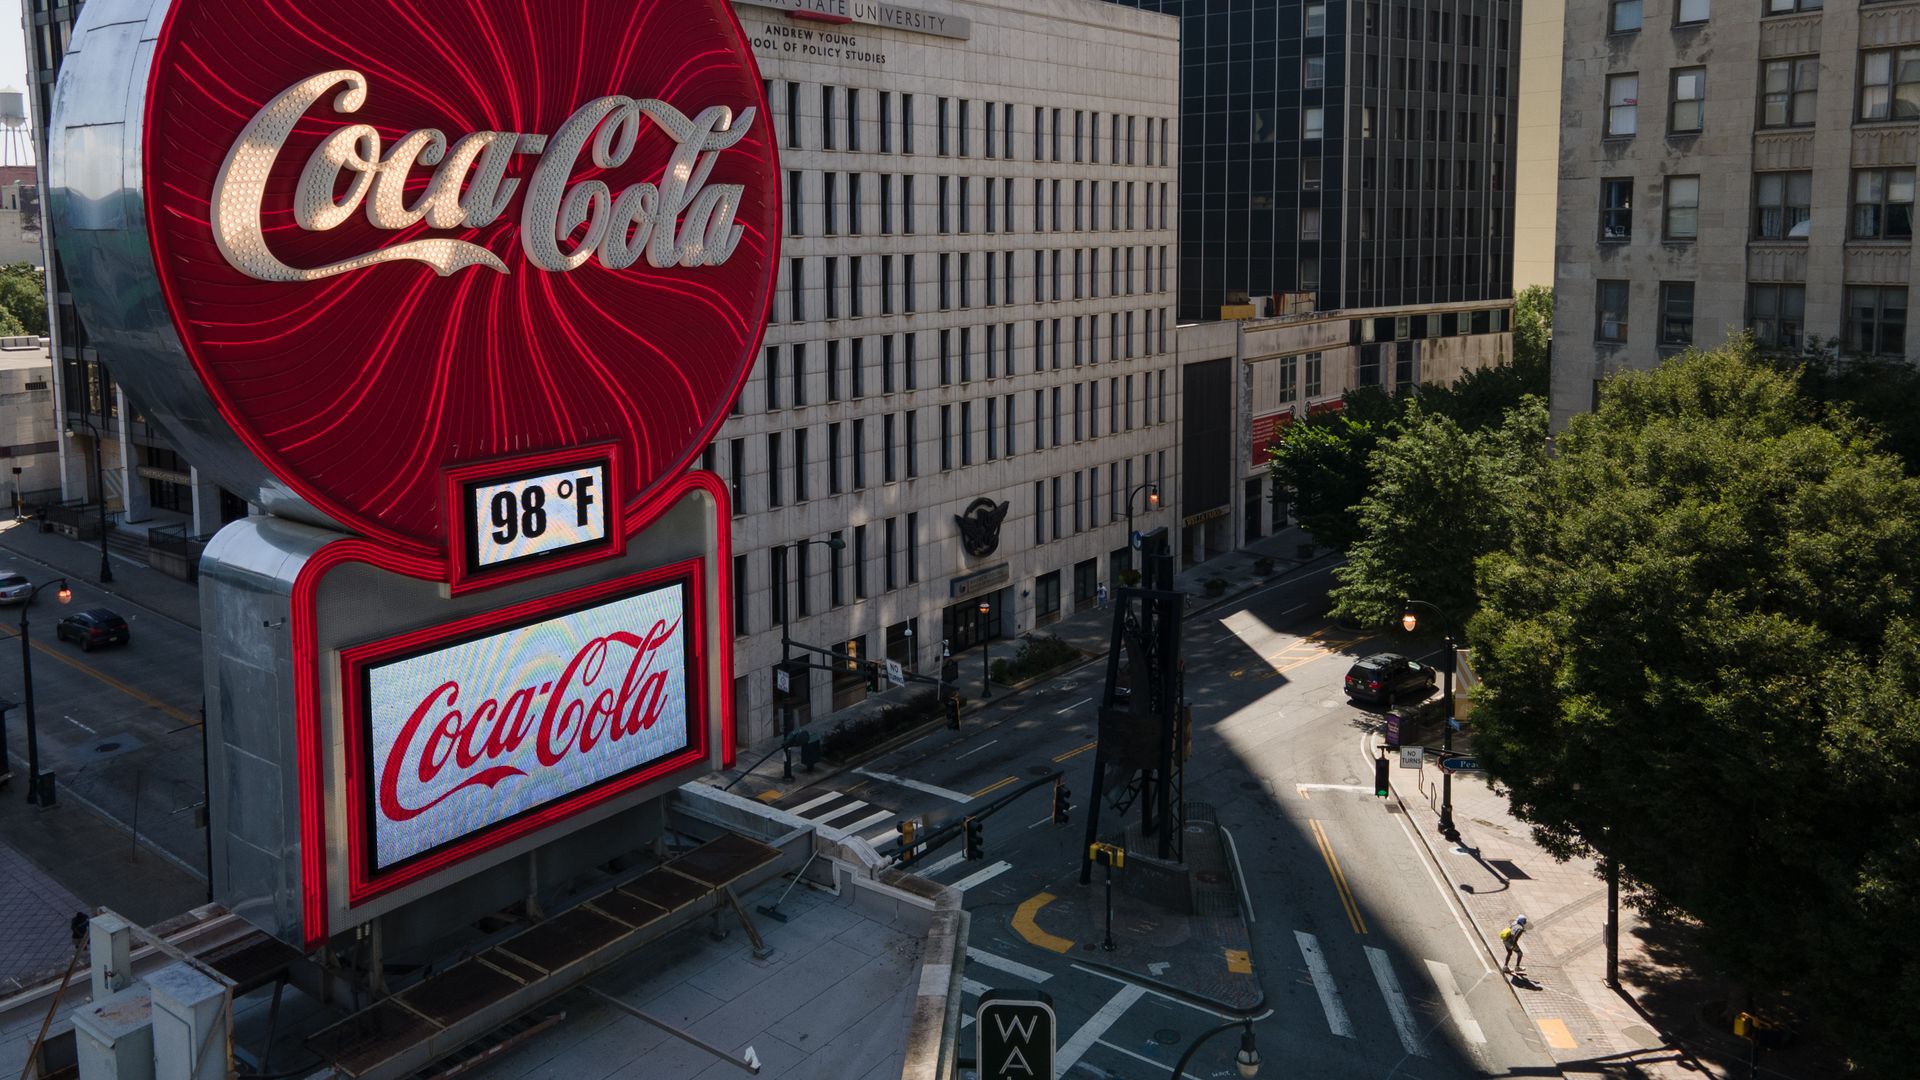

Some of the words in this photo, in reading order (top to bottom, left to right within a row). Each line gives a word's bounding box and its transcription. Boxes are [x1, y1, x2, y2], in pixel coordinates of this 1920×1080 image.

[765, 25, 813, 40] ANDREW
[819, 32, 856, 47] YOUNG
[855, 3, 945, 32] UNIVERSITY
[783, 41, 797, 53] OF
[803, 44, 840, 58] POLICY
[846, 50, 886, 64] STUDIES
[211, 70, 756, 281] Coca-Cola
[491, 485, 547, 545] 98
[557, 476, 593, 527] °F
[889, 663, 899, 673] NO
[379, 614, 683, 822] Coca-Cola
[994, 1013, 1038, 1080] WA
